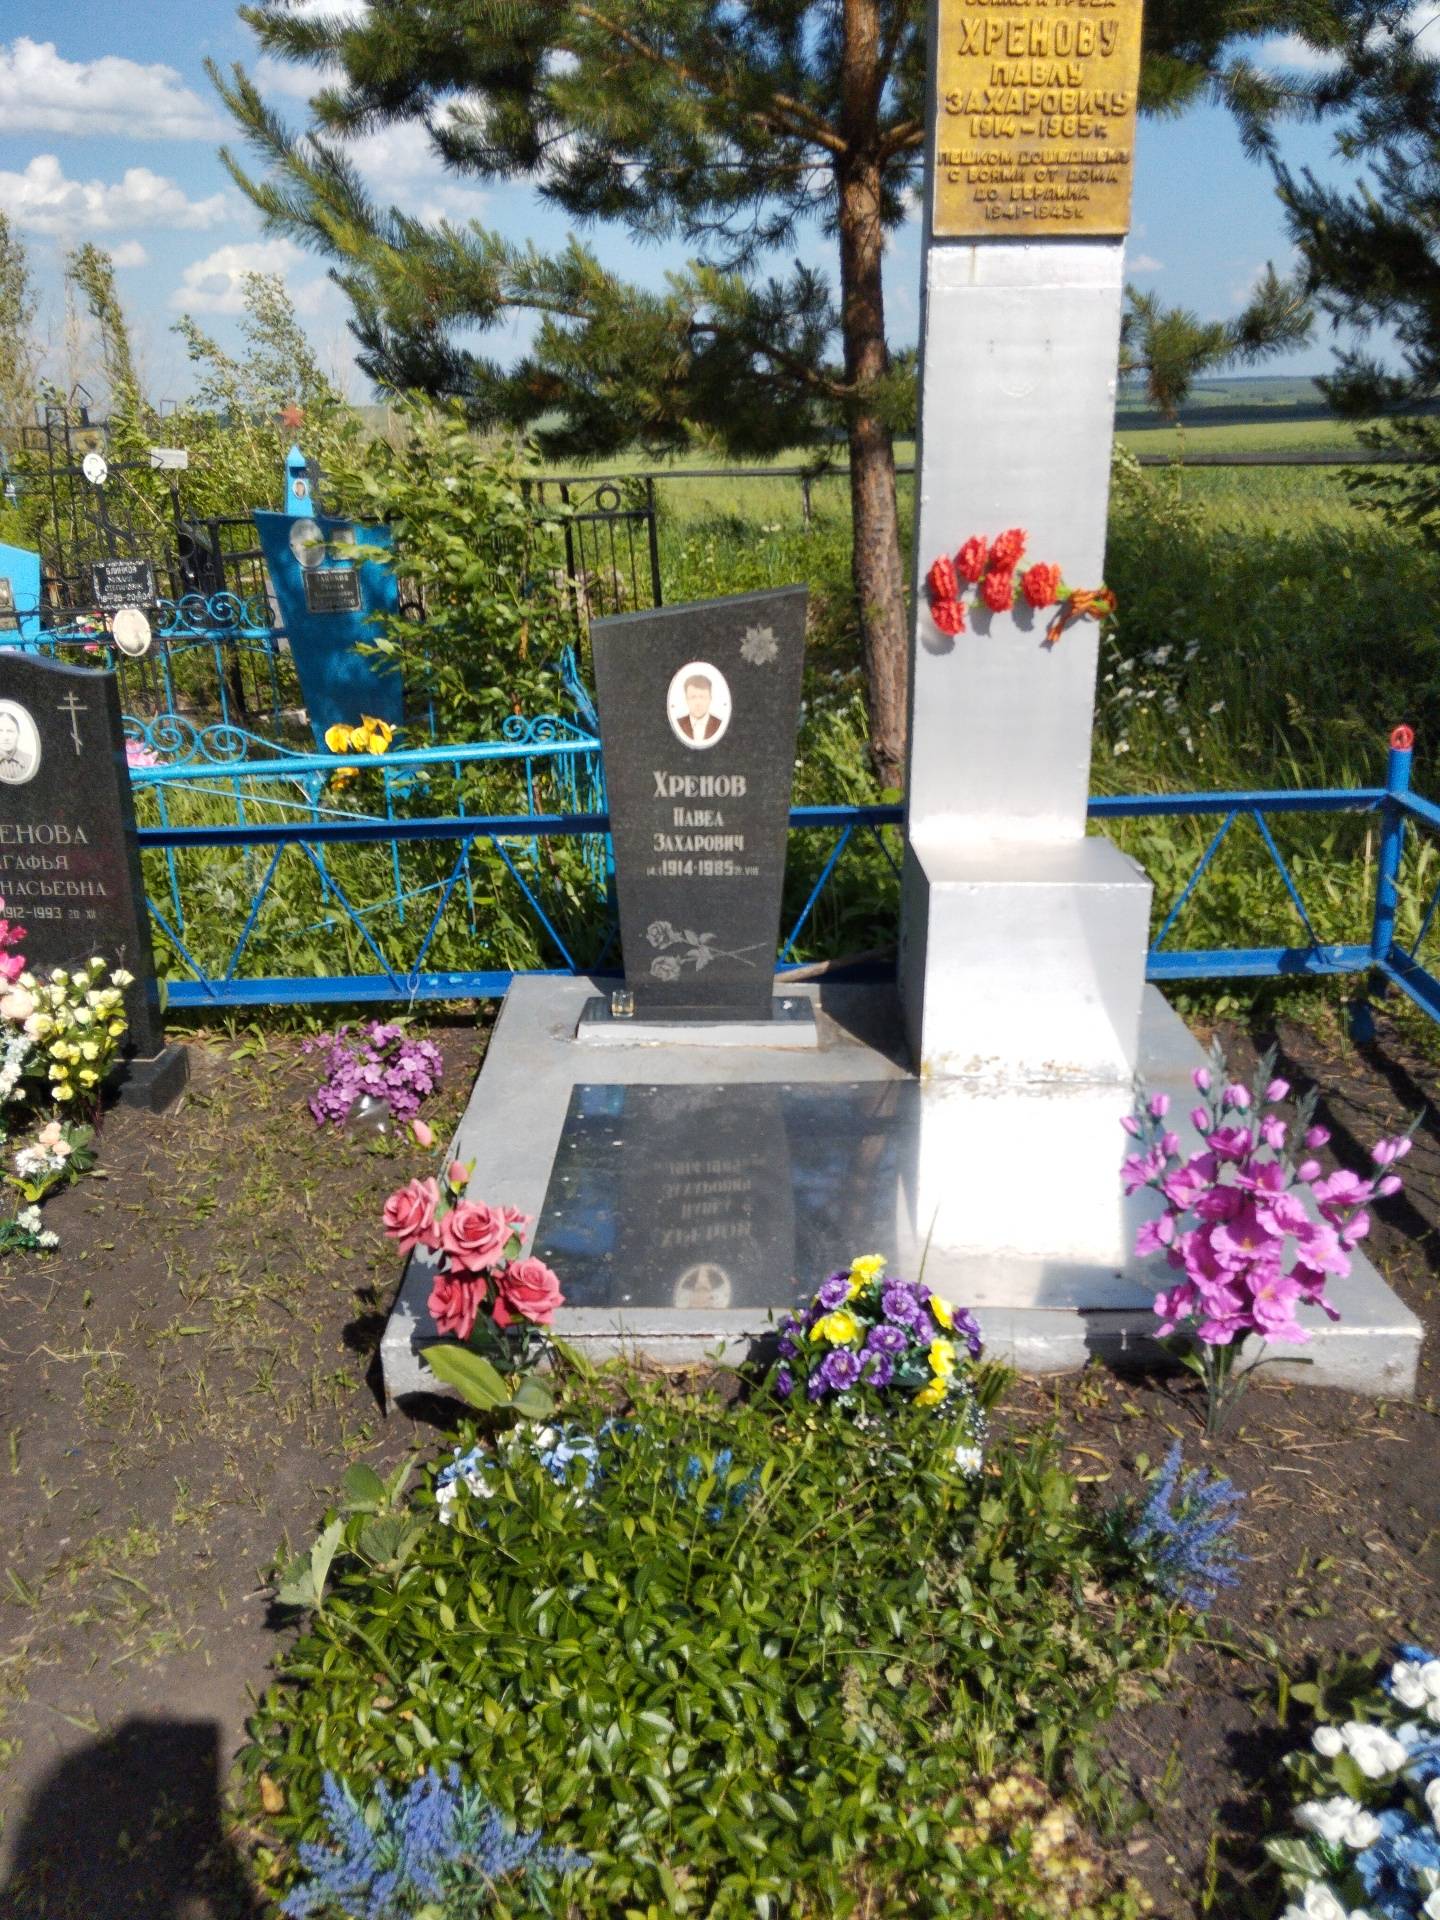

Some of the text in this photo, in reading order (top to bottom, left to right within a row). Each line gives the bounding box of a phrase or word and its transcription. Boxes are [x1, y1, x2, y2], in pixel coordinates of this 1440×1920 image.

[957, 17, 1120, 57] ХРЕНОВУ
[990, 61, 1084, 88] ПАВЛУ
[944, 88, 1129, 117] ЗАХАРОВИЧУ
[1033, 168, 1059, 184] ОТ
[973, 187, 1000, 202] ДО
[652, 770, 747, 798] ХРЕНОВ
[672, 807, 725, 828] ПАВЕЛ
[653, 832, 745, 852] ЗАХАРОВИЧ
[0, 855, 69, 870] ГАФЬЯ
